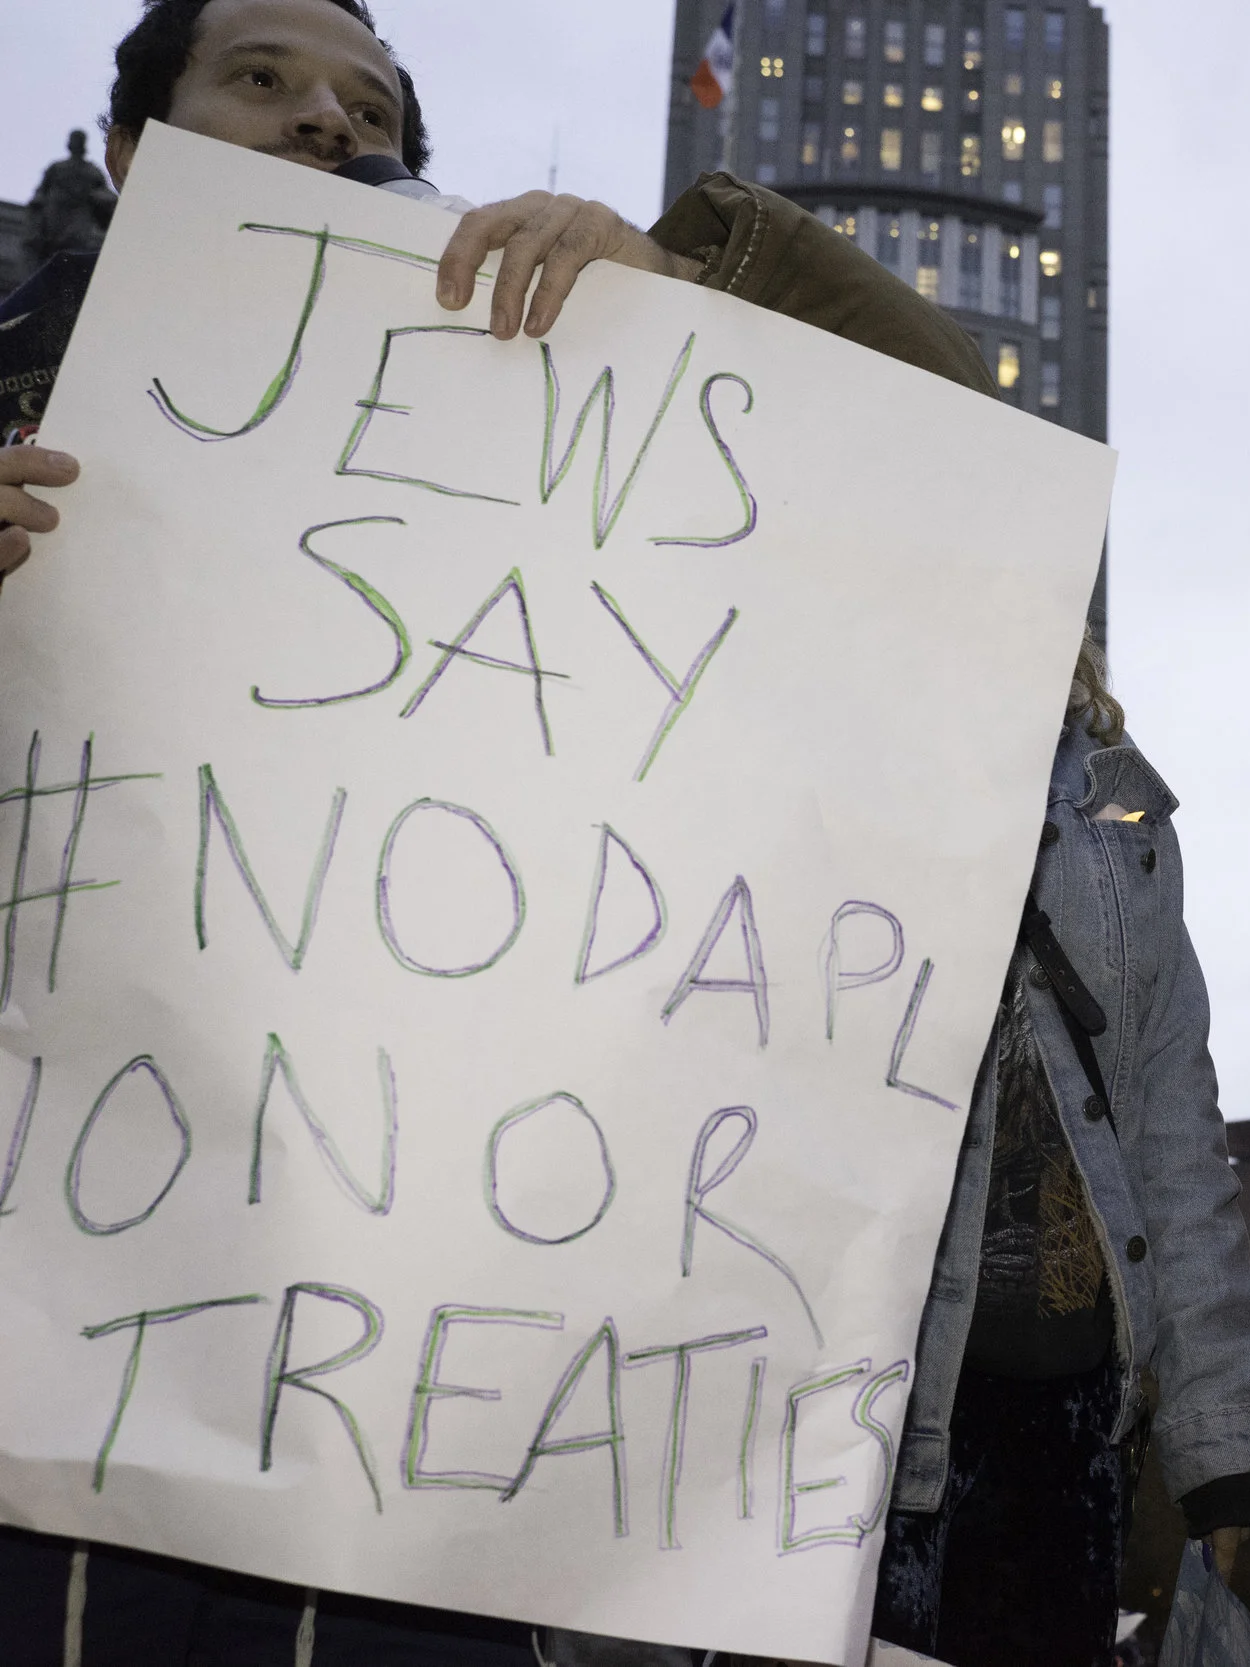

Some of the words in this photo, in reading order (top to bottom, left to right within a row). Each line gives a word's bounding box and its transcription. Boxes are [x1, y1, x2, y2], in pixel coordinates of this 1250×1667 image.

[147, 223, 757, 549] JEWS
[251, 516, 740, 782] SAY
[0, 730, 960, 1111] #NODAPL
[80, 1281, 909, 1556] TREATIES
